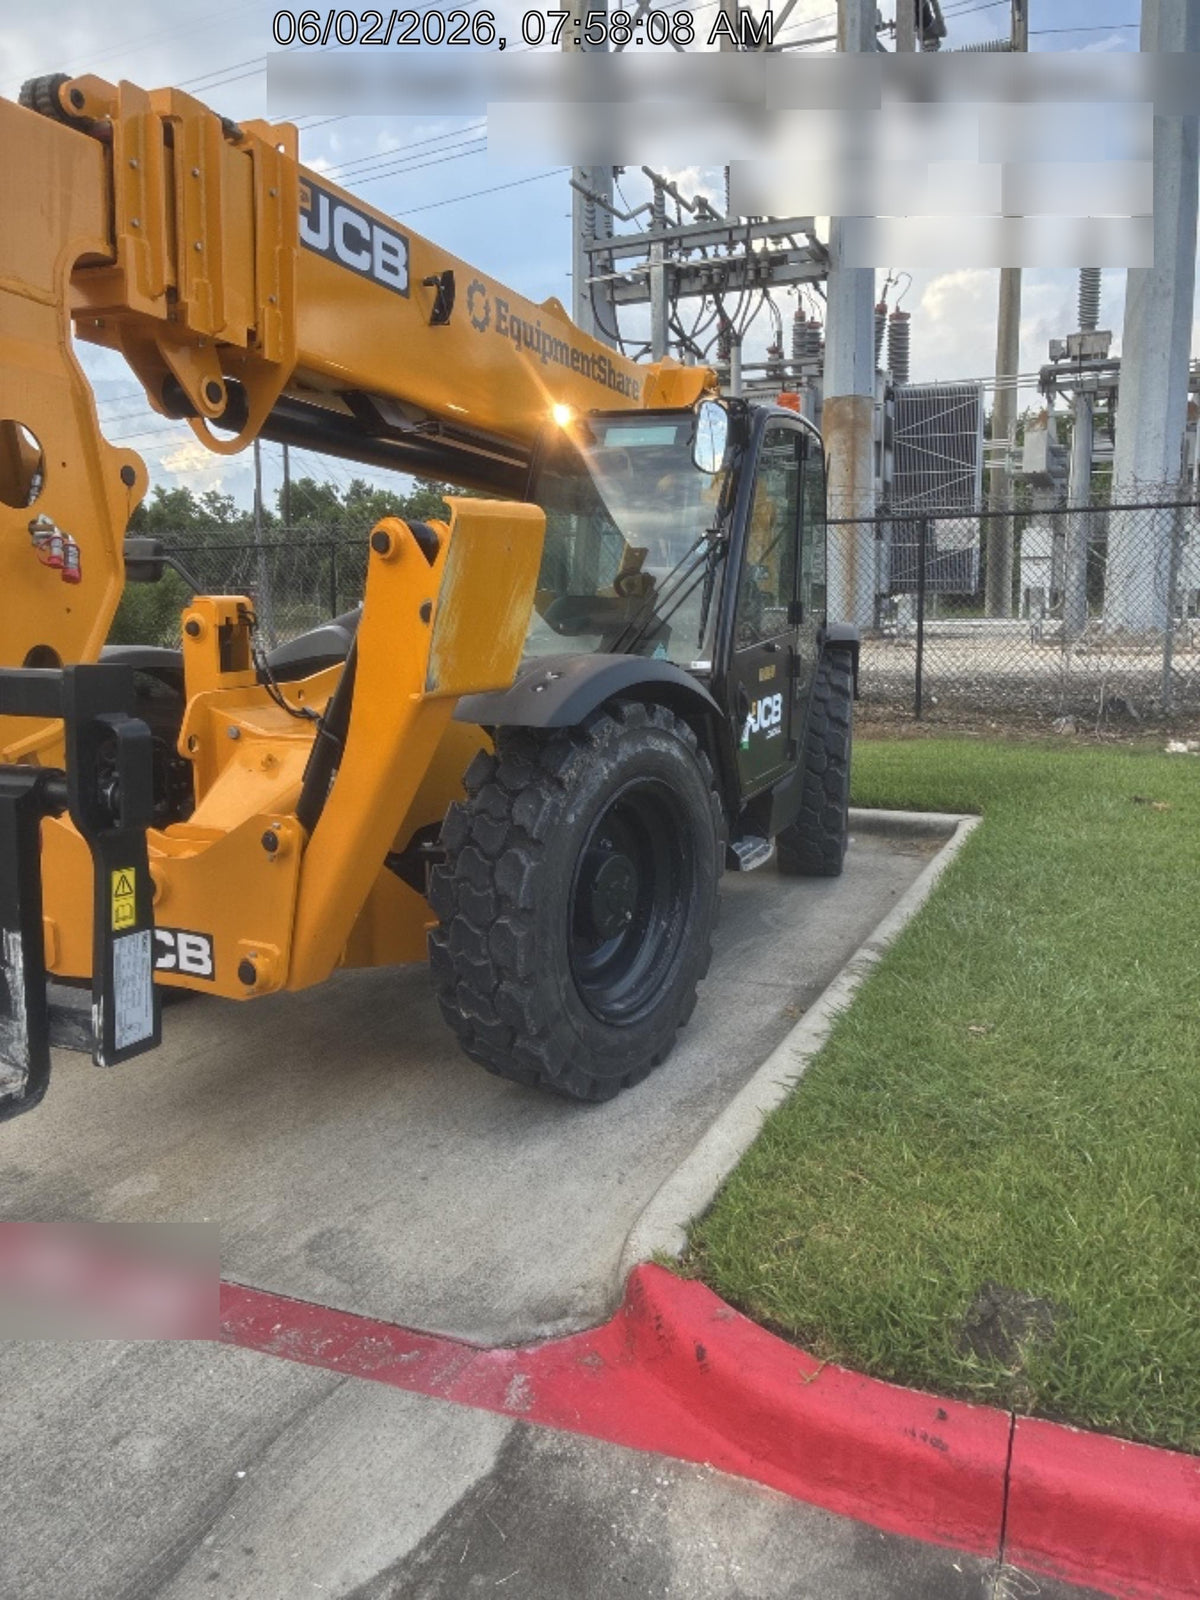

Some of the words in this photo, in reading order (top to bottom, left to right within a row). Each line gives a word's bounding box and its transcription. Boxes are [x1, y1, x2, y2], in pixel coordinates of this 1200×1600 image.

[299, 193, 408, 291] JCB
[495, 296, 641, 401] EquipmentShare
[749, 693, 783, 733] JCB
[154, 929, 213, 975] CB
